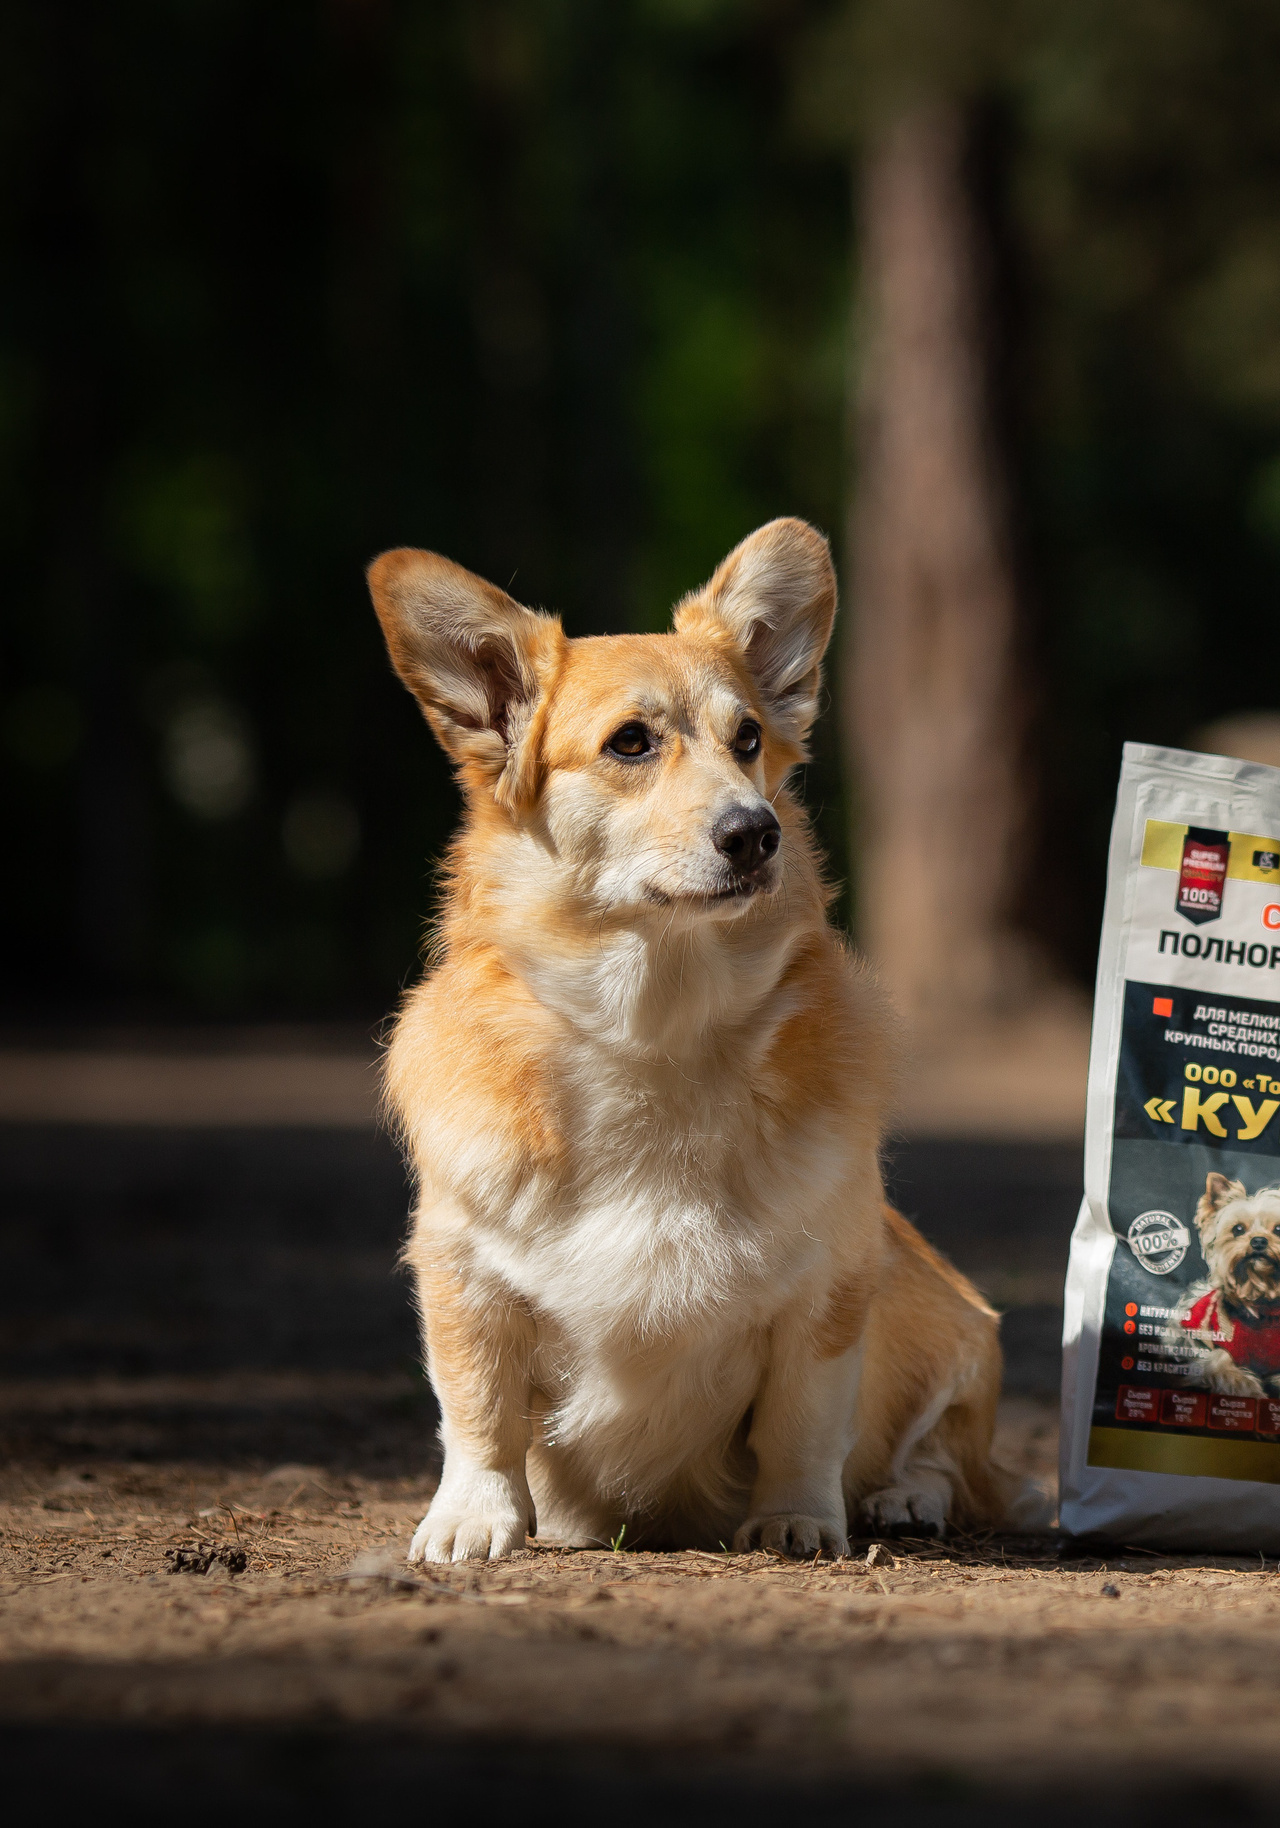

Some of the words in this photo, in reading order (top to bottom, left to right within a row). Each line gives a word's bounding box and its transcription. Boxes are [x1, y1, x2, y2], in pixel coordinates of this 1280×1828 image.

[1182, 857, 1225, 872] PREMIUM
[1190, 849, 1221, 862] SUPER
[1181, 887, 1220, 906] 100%
[1193, 1004, 1227, 1023] ДЛЯ
[1164, 1030, 1236, 1054] КРУПНЫХ
[1207, 1023, 1279, 1045] СРЕДНИХ
[1183, 1062, 1237, 1089] ООО
[1134, 1215, 1172, 1232] NATURAL
[1133, 1229, 1178, 1254] 100%
[1138, 1323, 1153, 1336] БЕЗ
[1137, 1360, 1152, 1372] БЕЗ
[1211, 1407, 1254, 1419] Клетчатка
